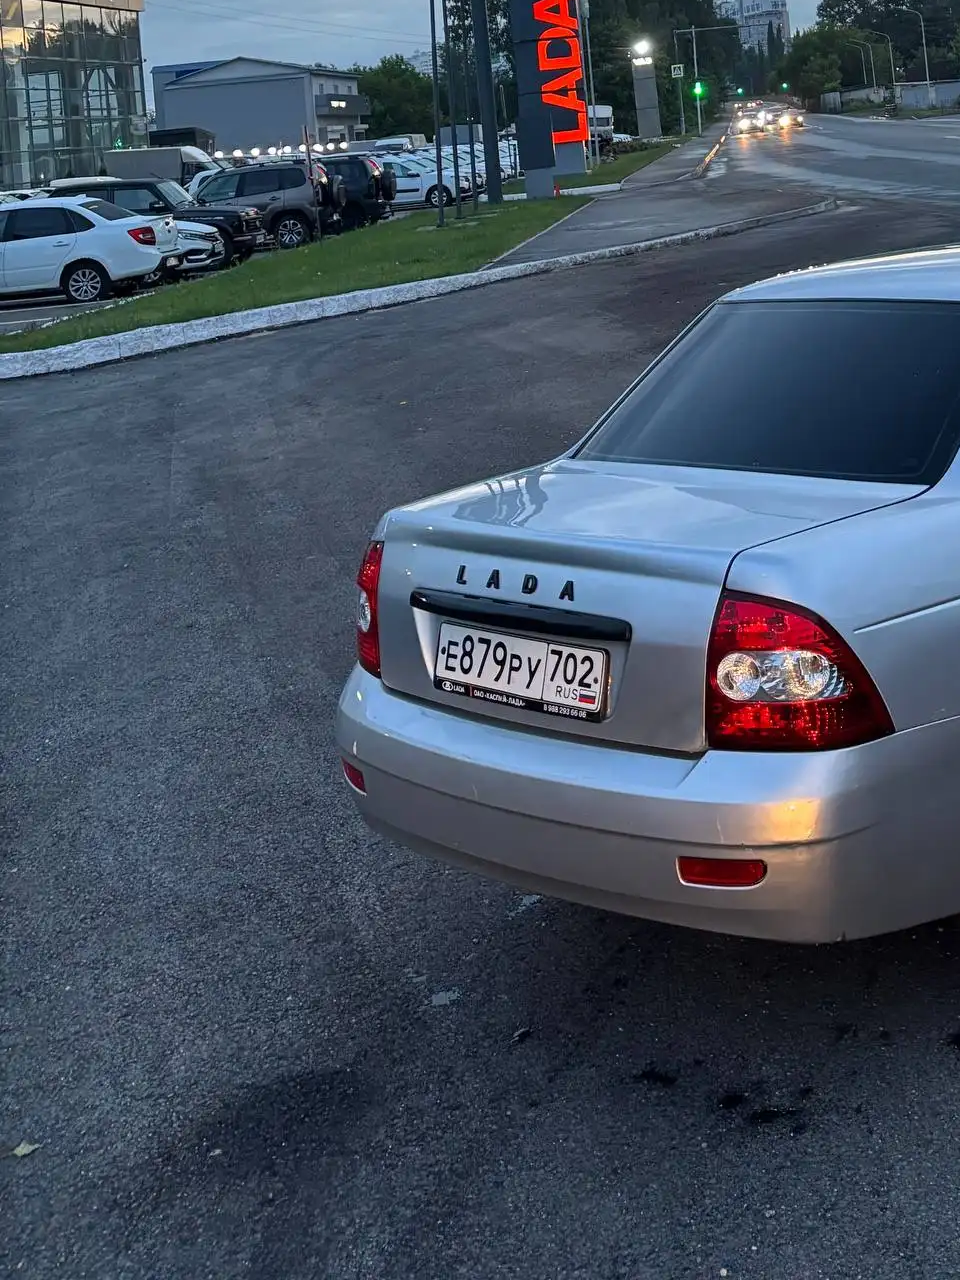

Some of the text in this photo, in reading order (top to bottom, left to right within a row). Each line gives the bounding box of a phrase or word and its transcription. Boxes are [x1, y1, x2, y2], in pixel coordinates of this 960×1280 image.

[456, 564, 575, 602] LADA
[549, 649, 594, 689] 702
[453, 684, 465, 693] LADA
[555, 685, 578, 700] RUS
